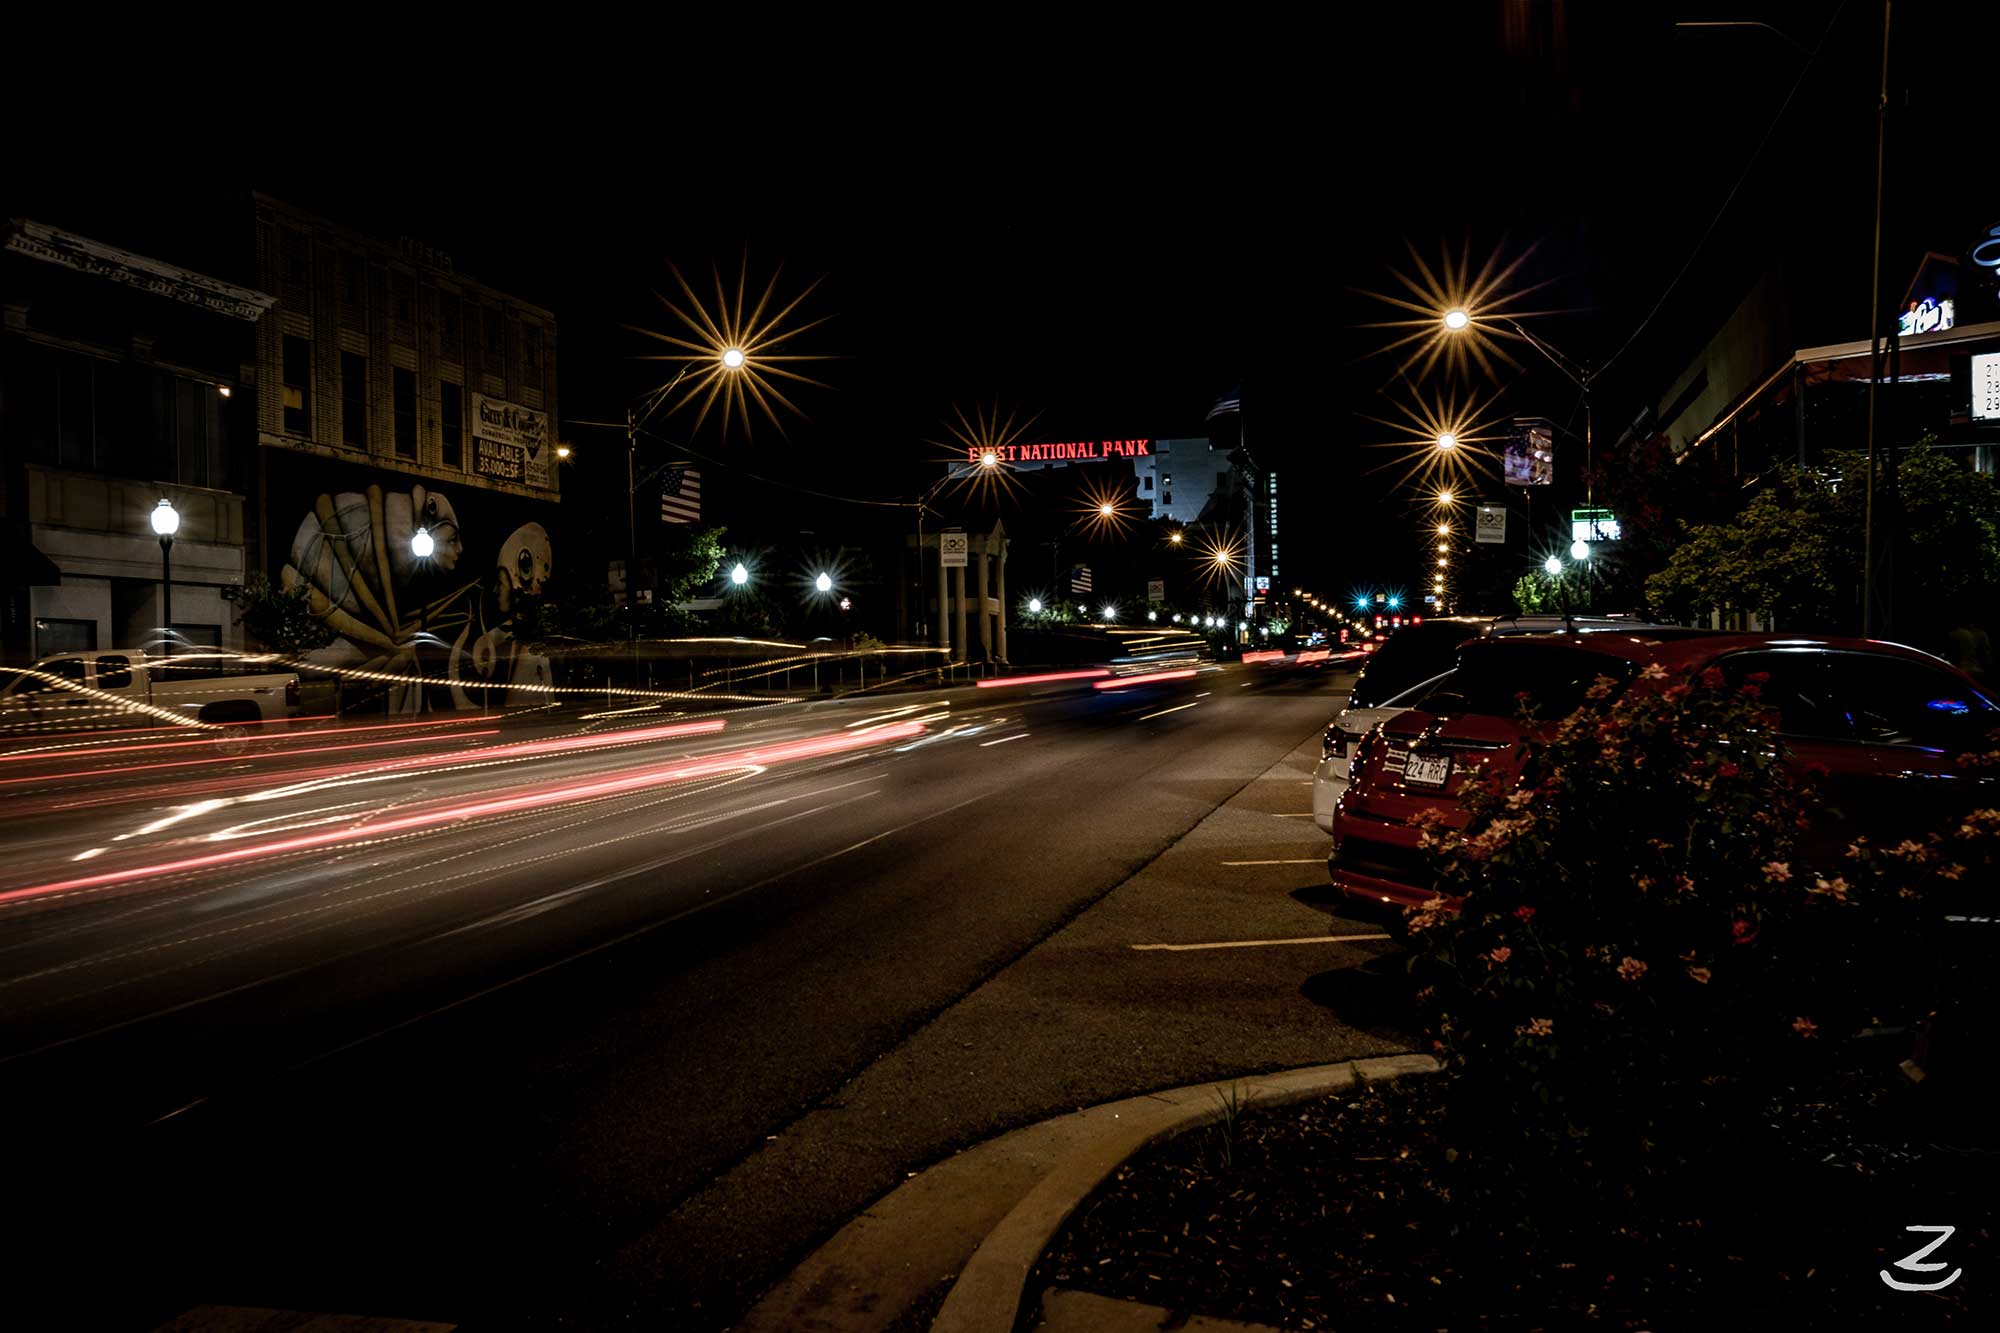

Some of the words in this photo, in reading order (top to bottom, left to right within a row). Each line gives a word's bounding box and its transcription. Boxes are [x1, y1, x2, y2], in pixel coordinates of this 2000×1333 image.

[479, 439, 521, 463] AVAILABLE
[1020, 442, 1098, 461] NATIONAL
[1101, 439, 1149, 457] BANK
[1406, 761, 1425, 778] 224
